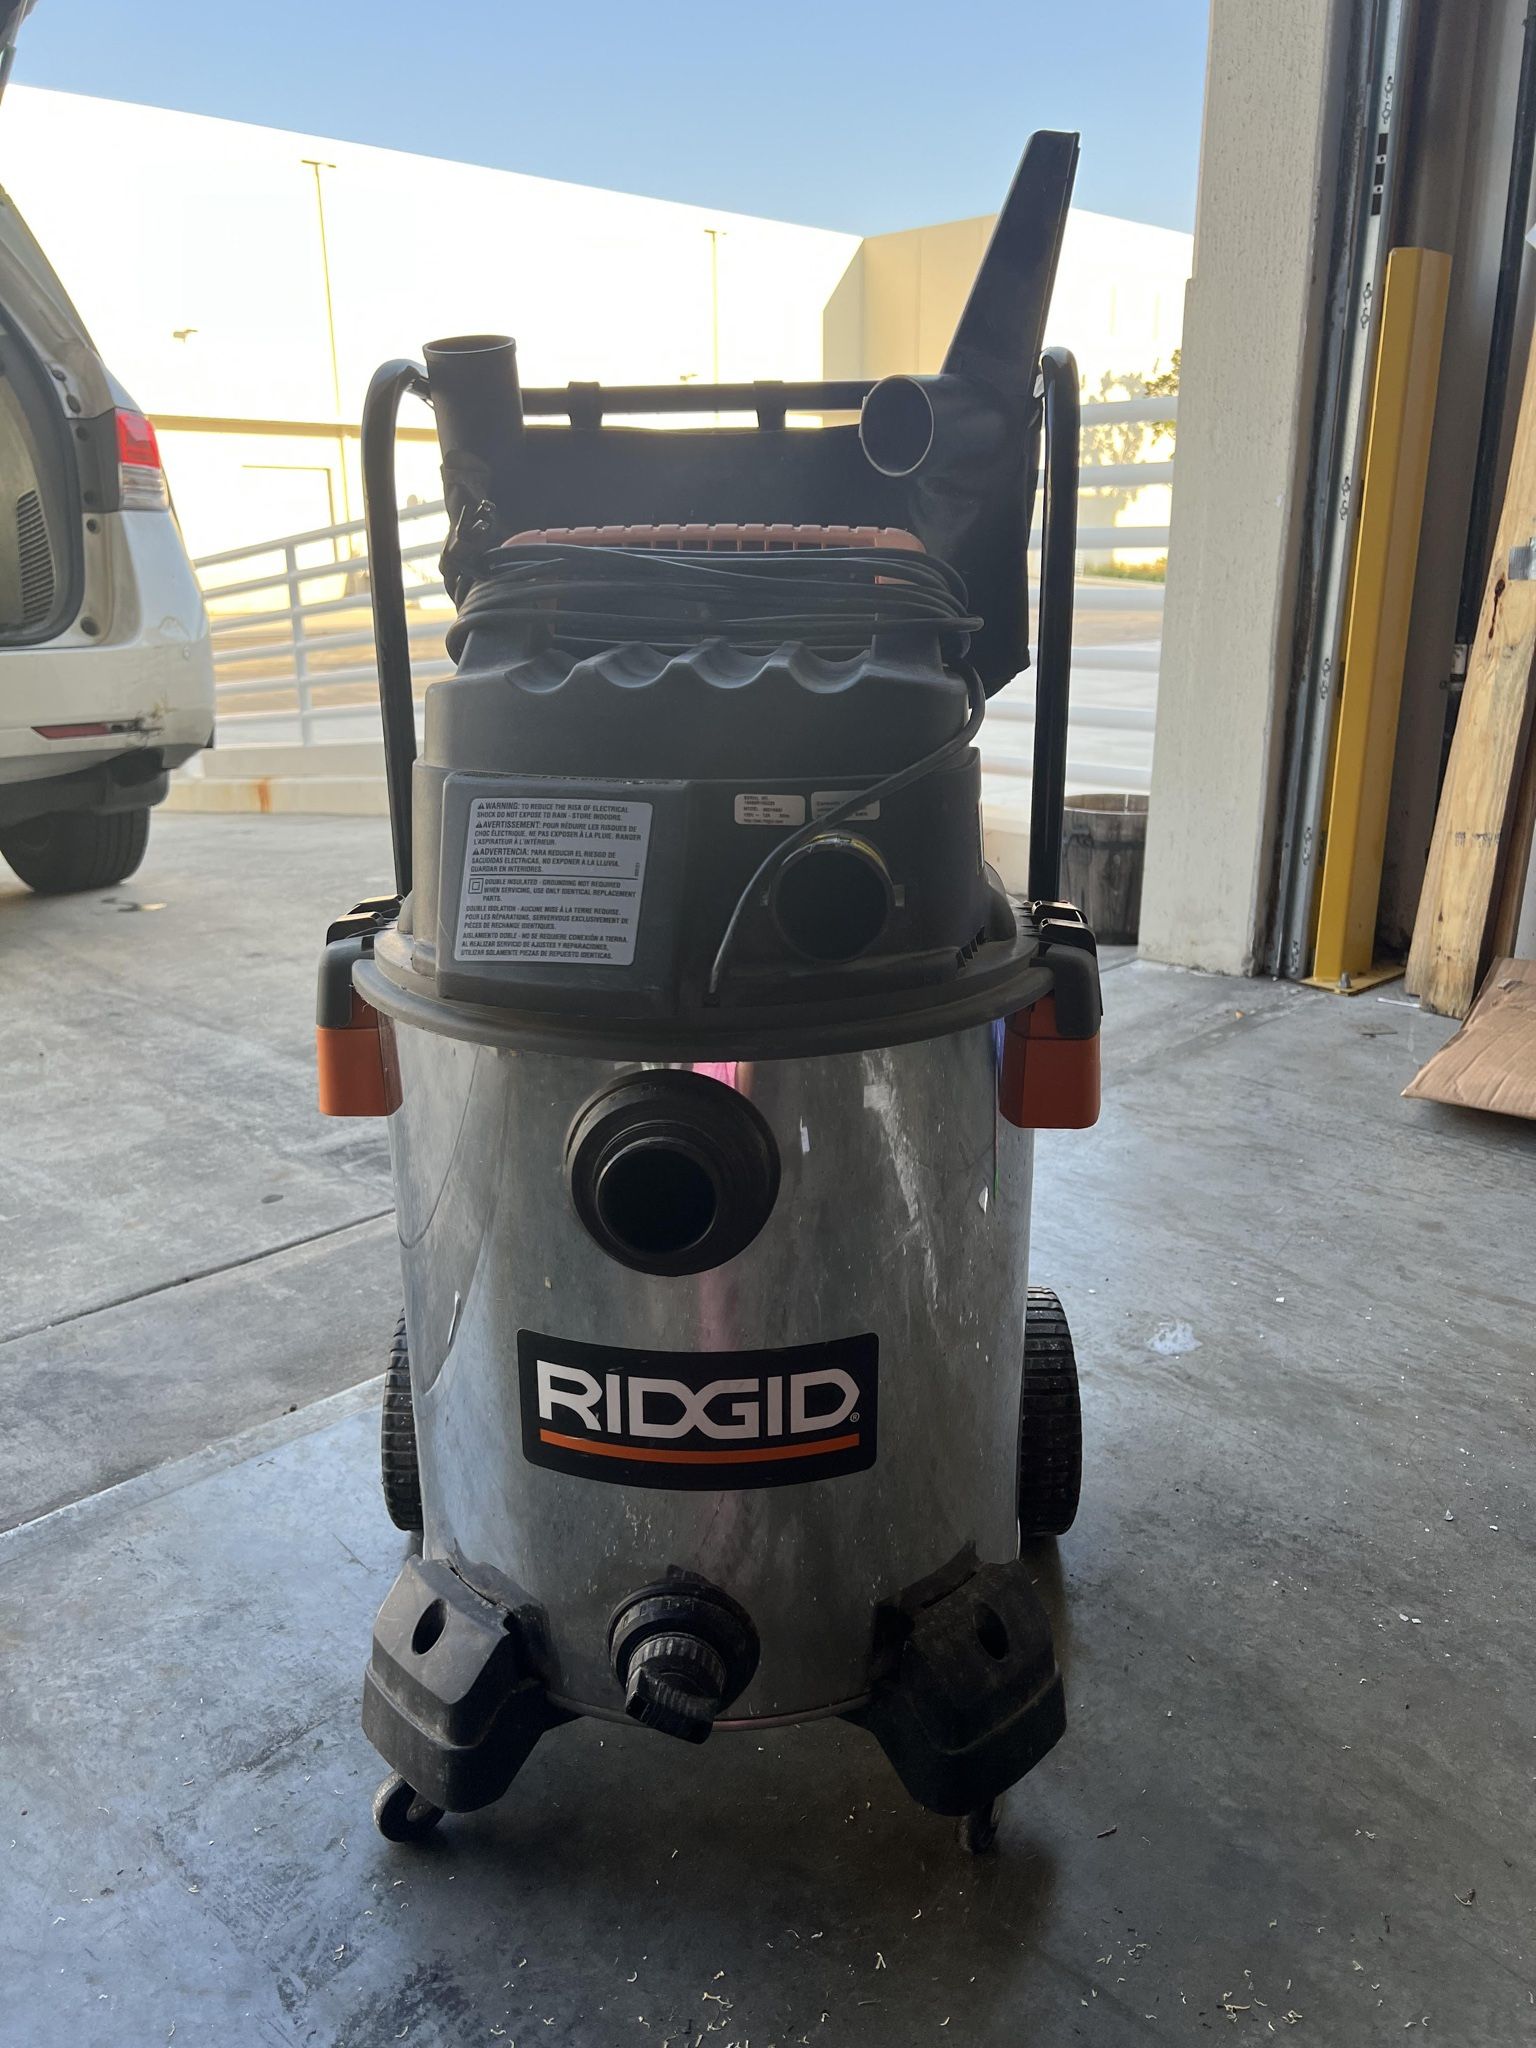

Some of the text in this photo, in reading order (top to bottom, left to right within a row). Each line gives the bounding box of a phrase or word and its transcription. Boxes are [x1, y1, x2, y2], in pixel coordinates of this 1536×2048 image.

[483, 820, 542, 829] AVERTISSEMENT:
[560, 822, 587, 830] RÉDUIRE
[480, 847, 529, 856] ADVERTENCIA:
[568, 933, 599, 941] CONEXIÓN
[537, 1359, 860, 1440] RIDGID
